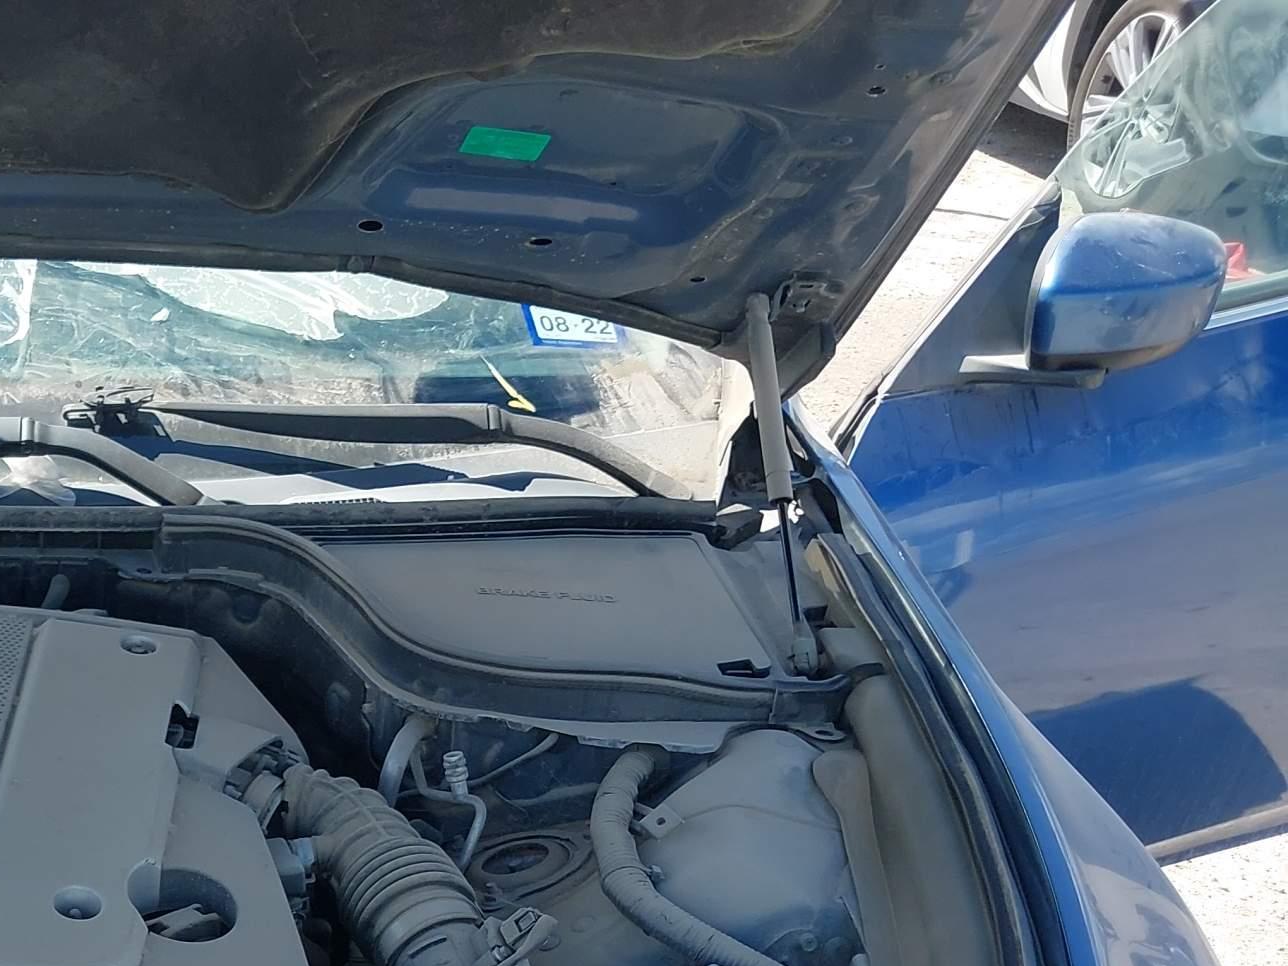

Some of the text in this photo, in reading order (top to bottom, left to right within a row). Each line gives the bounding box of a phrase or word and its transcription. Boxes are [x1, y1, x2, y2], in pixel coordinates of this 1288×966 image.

[539, 315, 570, 333] 08
[476, 586, 619, 604] BRAKE FLUID
